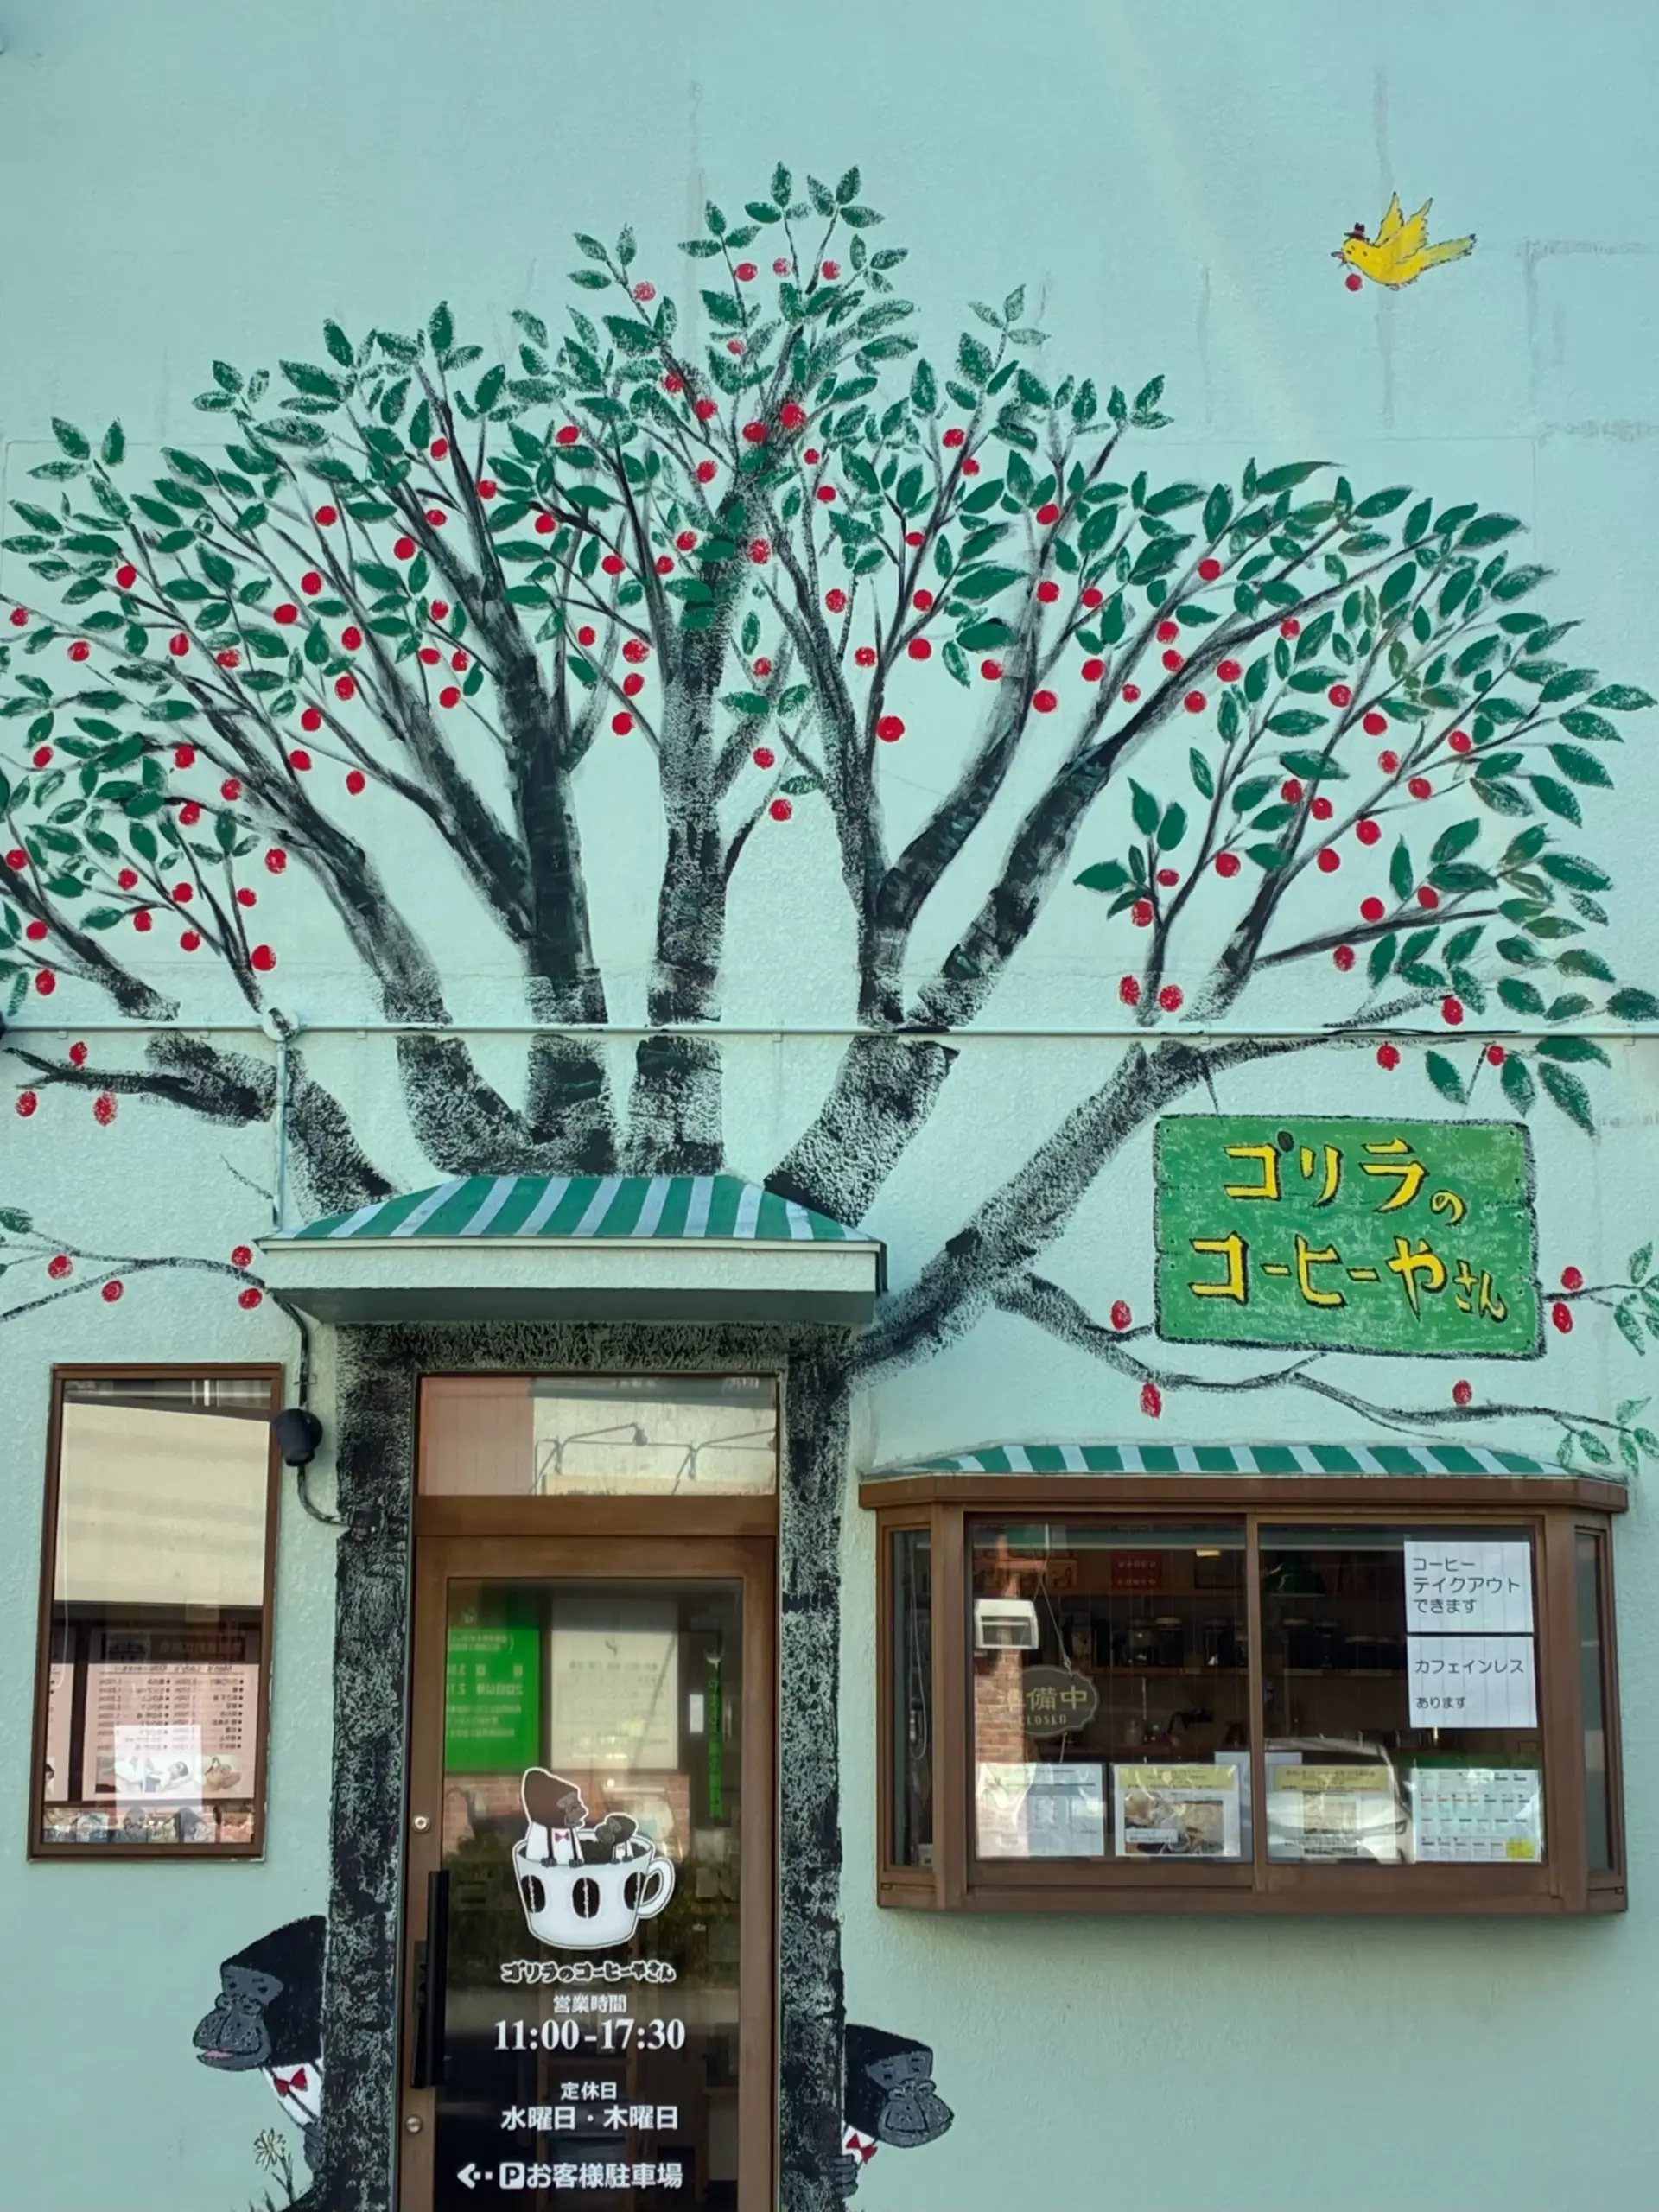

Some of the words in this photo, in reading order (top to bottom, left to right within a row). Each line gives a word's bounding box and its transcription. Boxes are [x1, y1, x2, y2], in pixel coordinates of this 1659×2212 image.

[1188, 1230, 1509, 1322] コーヒーやさん
[1413, 1557, 1476, 1572] コーヒー
[1413, 1577, 1522, 1594] テイクアウト
[1414, 1599, 1478, 1614] できます
[1415, 1659, 1525, 1674] カフェインレス
[1416, 1696, 1466, 1710] あります
[500, 1960, 677, 1984] ゴリラのコーヒーやさん
[553, 1994, 627, 2014] 営業時間
[494, 2018, 686, 2050] 11:00-17:30
[560, 2082, 618, 2101] 定休日
[500, 2106, 678, 2131] 水曜日・木曜日
